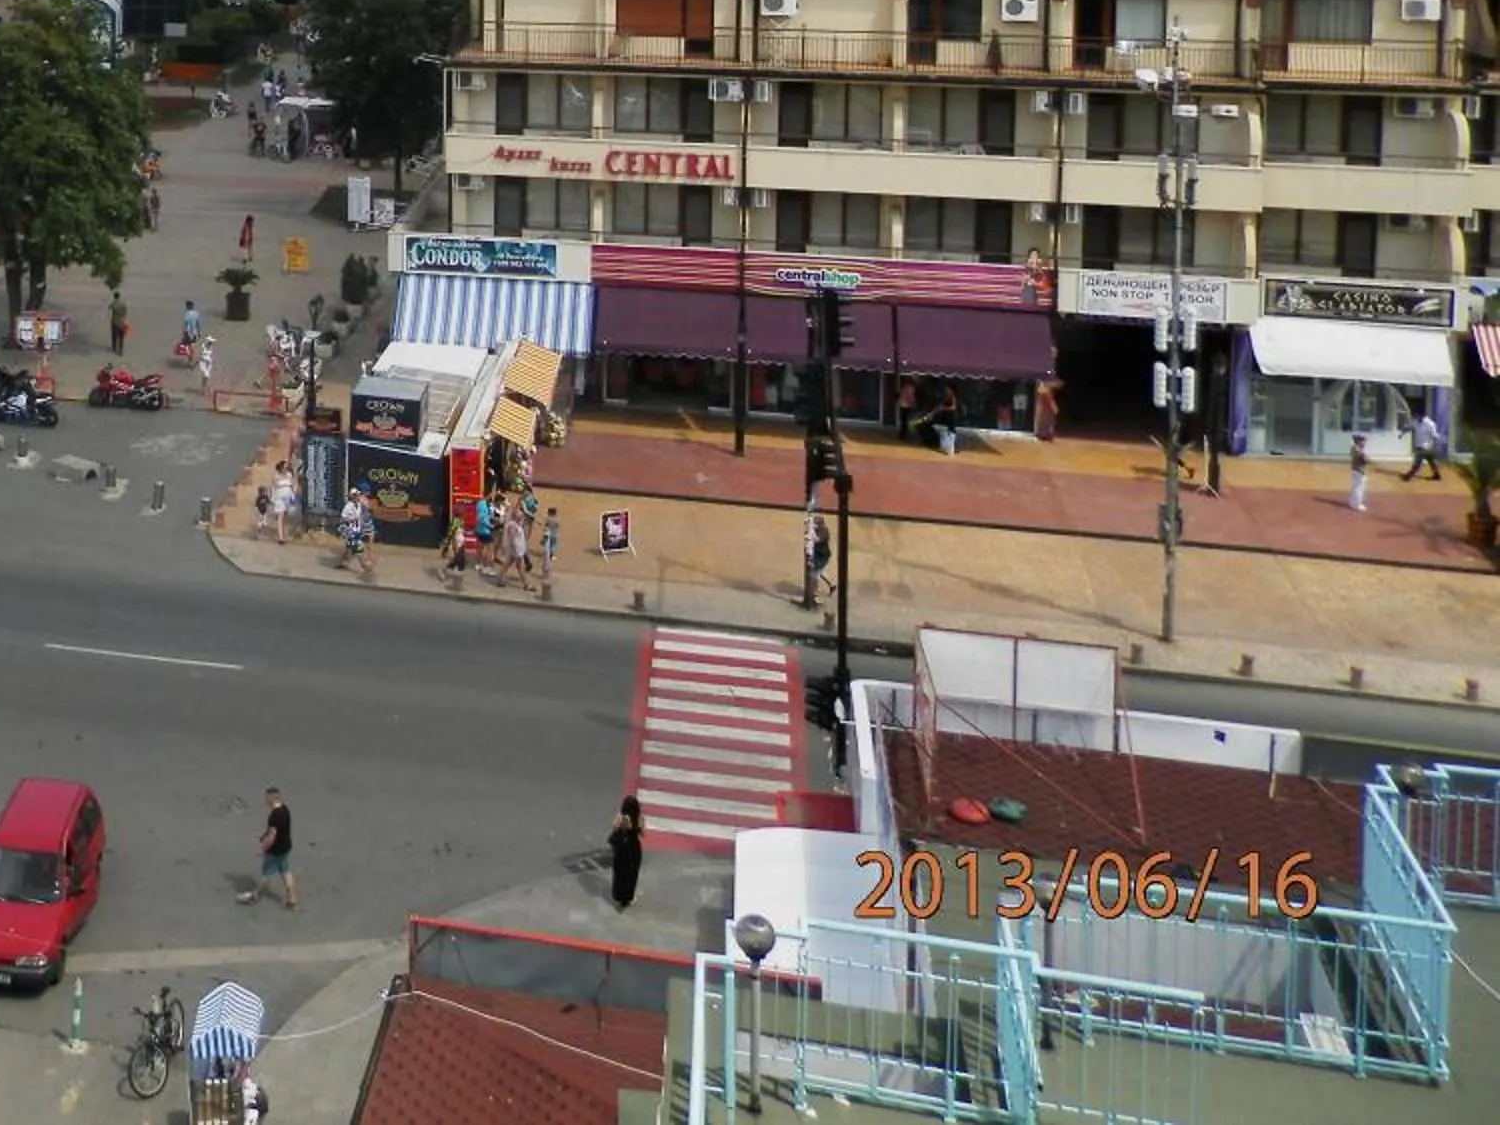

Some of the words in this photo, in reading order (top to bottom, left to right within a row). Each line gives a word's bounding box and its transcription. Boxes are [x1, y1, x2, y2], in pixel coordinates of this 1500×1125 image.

[605, 150, 735, 181] CENTRAL
[1091, 287, 1118, 298] NON
[1121, 290, 1154, 300] STOP
[1333, 290, 1392, 303] CASINO
